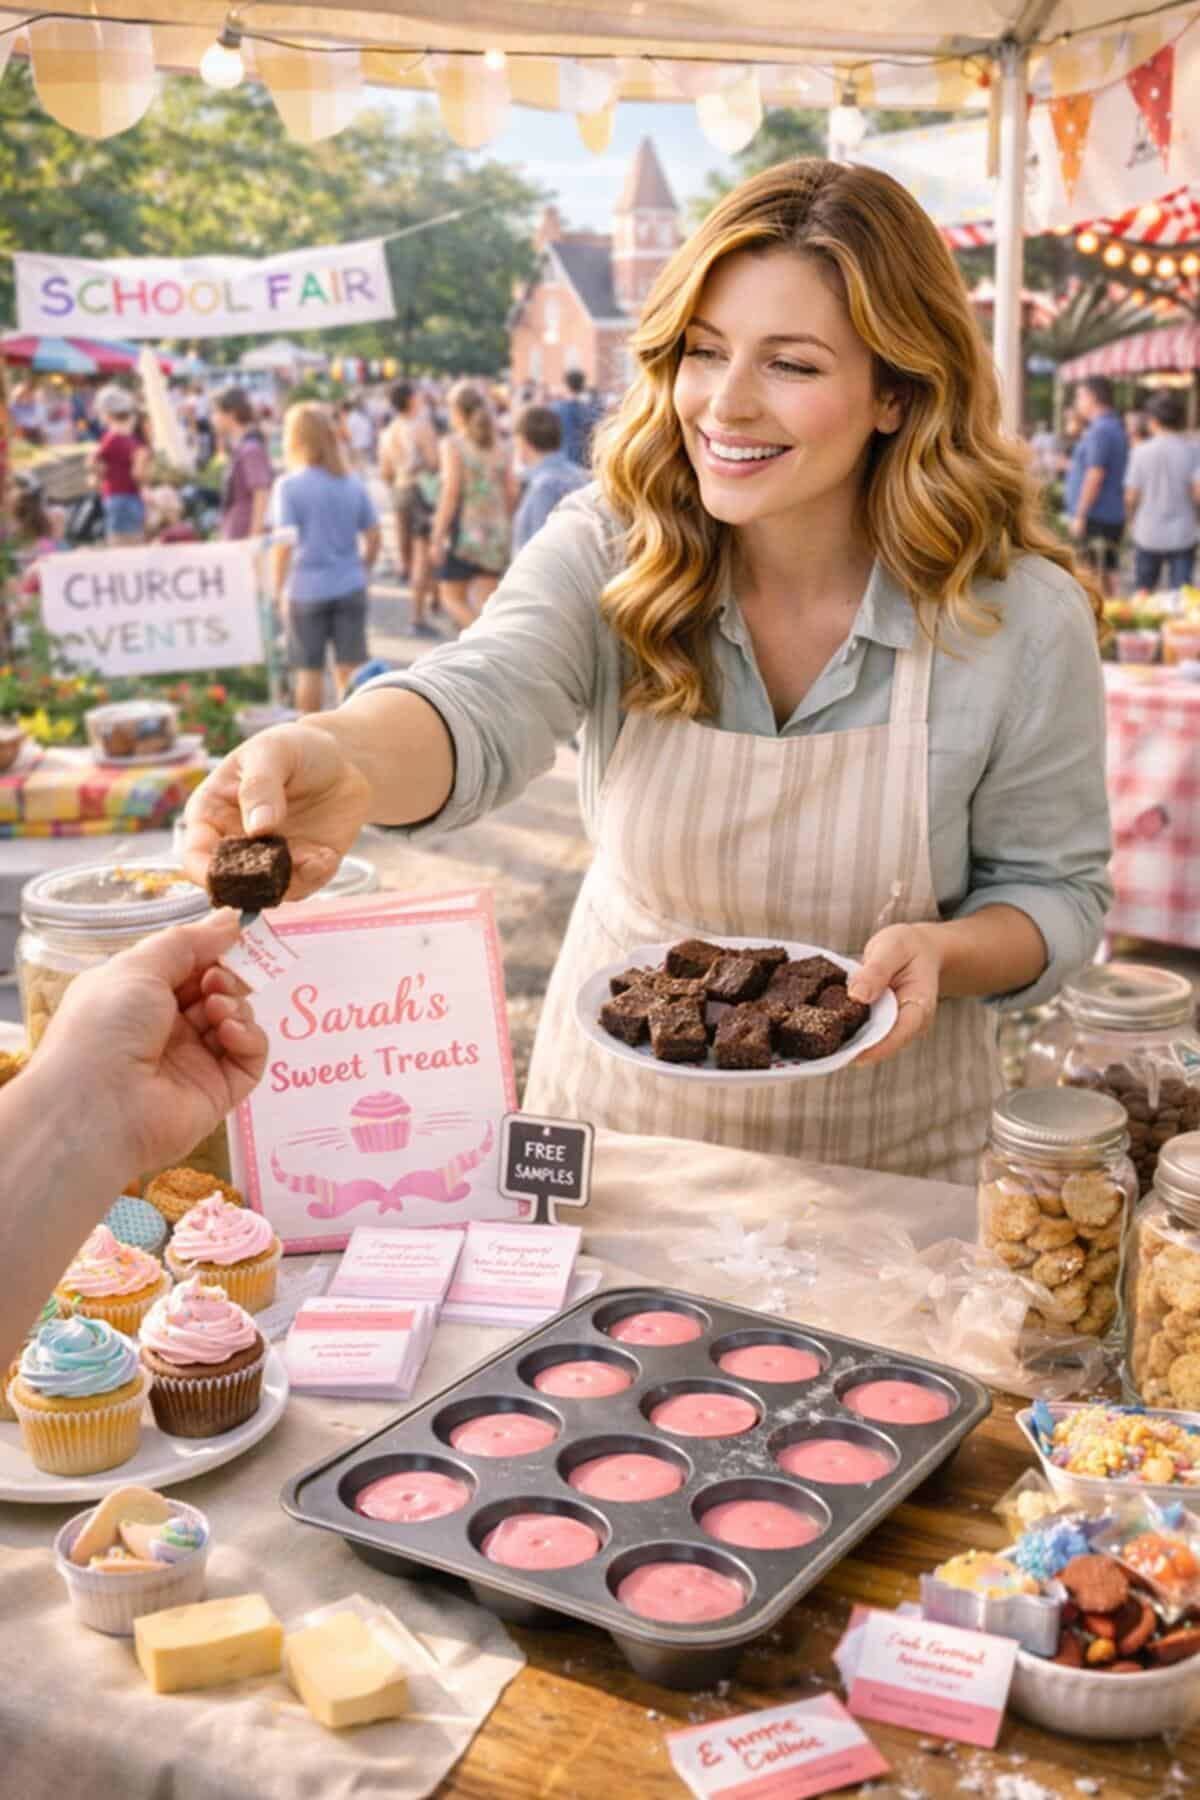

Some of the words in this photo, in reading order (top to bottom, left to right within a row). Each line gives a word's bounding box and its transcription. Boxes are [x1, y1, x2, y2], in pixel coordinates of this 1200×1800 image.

[41, 275, 252, 317] SCHOOL
[267, 267, 375, 309] FAIR
[63, 565, 225, 610] CHURCH
[64, 615, 230, 655] VENTS
[279, 972, 449, 1041] Sarah's
[271, 1054, 367, 1093] Sweet
[374, 1040, 479, 1076] Treats
[524, 1141, 566, 1162] FREE
[514, 1163, 574, 1186] SAMPLES
